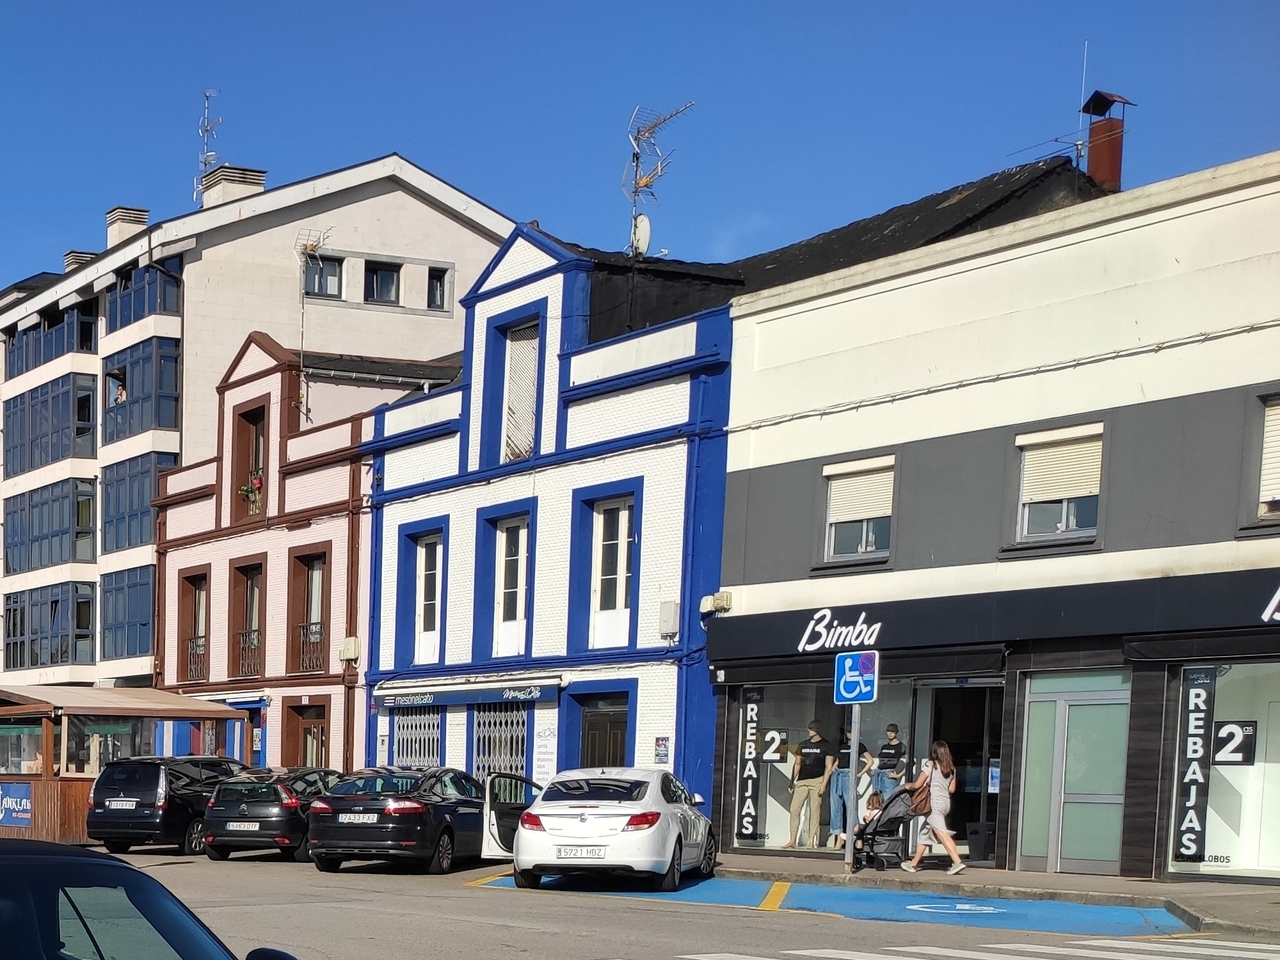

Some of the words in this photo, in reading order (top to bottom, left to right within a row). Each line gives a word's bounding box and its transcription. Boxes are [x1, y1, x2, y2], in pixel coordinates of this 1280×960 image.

[798, 608, 882, 652] Bimba
[741, 703, 758, 834] REBAJAS
[1179, 688, 1207, 855] REBAJAS
[563, 848, 583, 857] 5721
